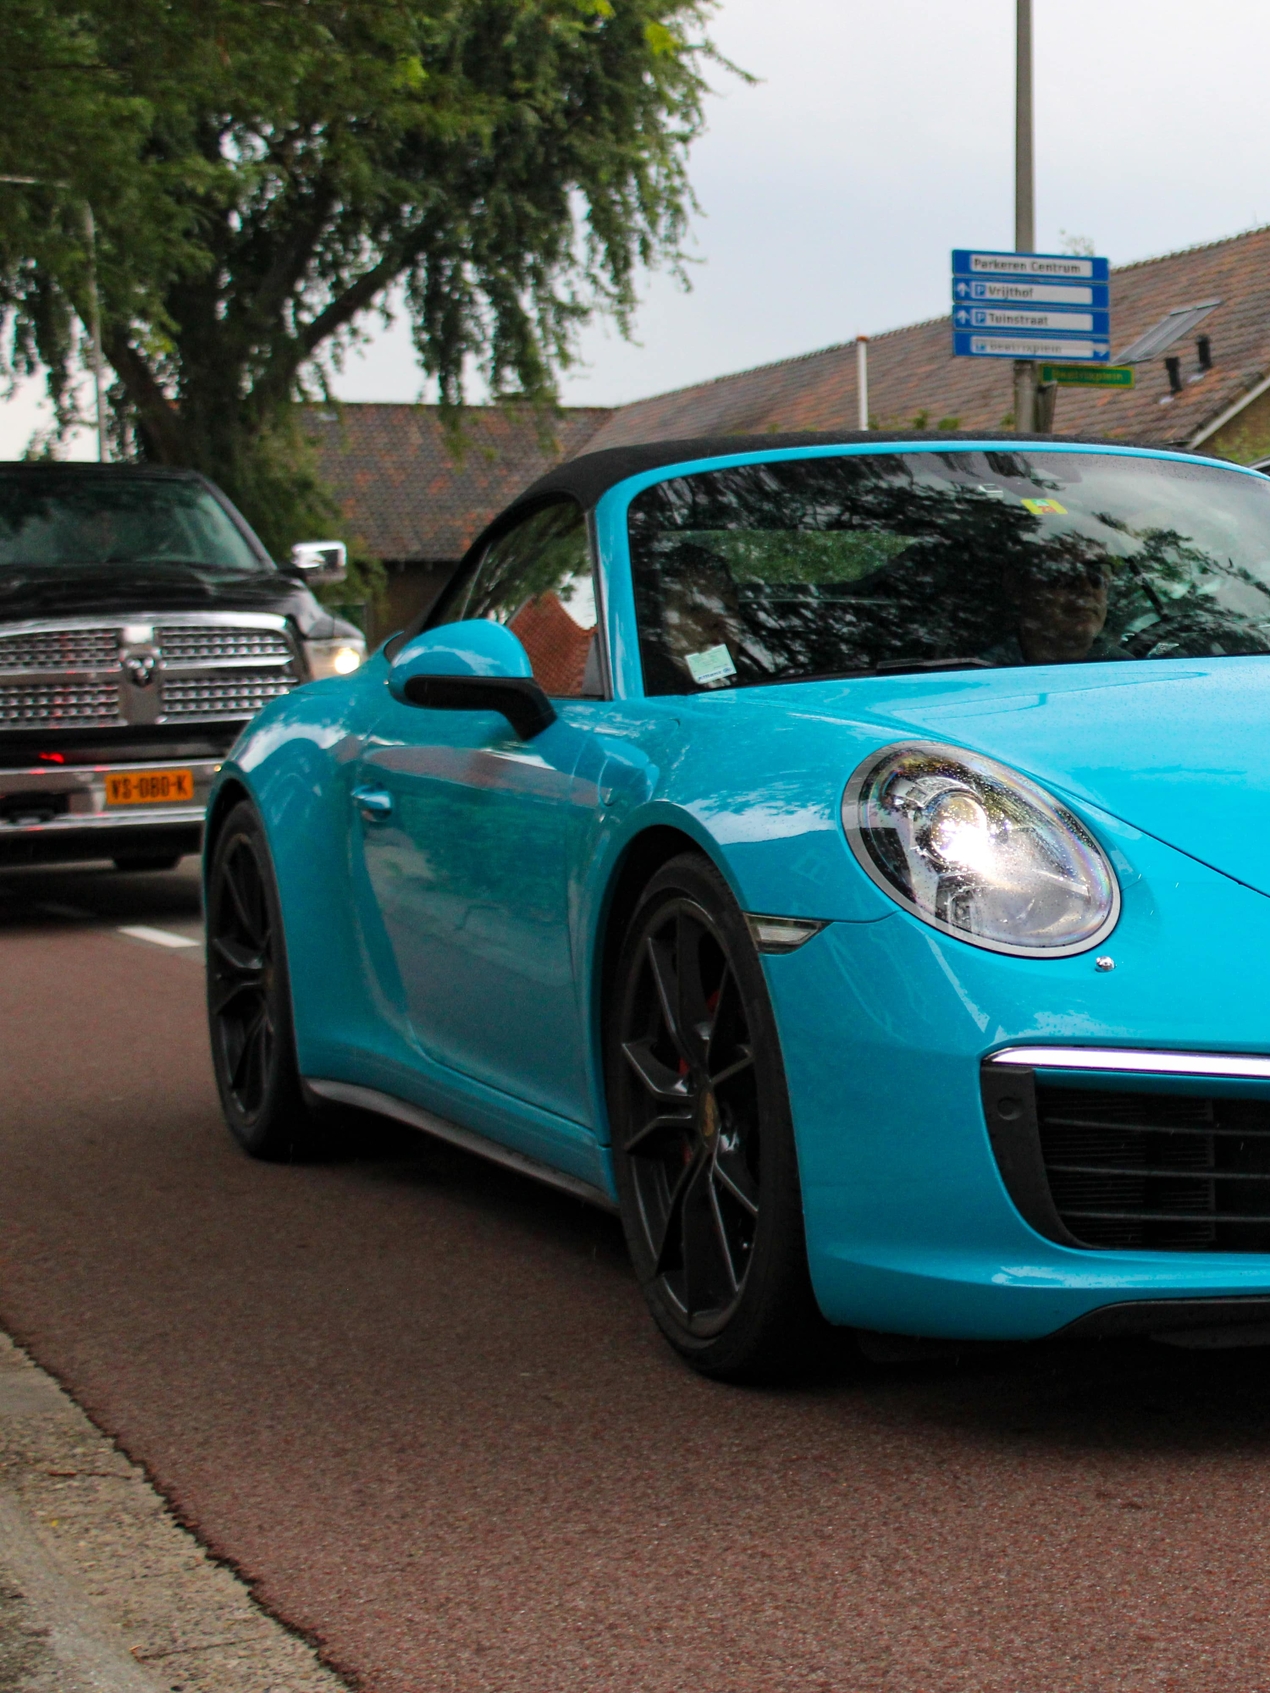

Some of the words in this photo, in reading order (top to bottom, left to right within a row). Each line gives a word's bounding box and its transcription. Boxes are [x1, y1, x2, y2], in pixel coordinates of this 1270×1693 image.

[974, 258, 1026, 270] Parkeren
[1031, 261, 1081, 274] Centrum
[989, 286, 1034, 300] Vrijthof
[989, 313, 1049, 326] Tuinstraat
